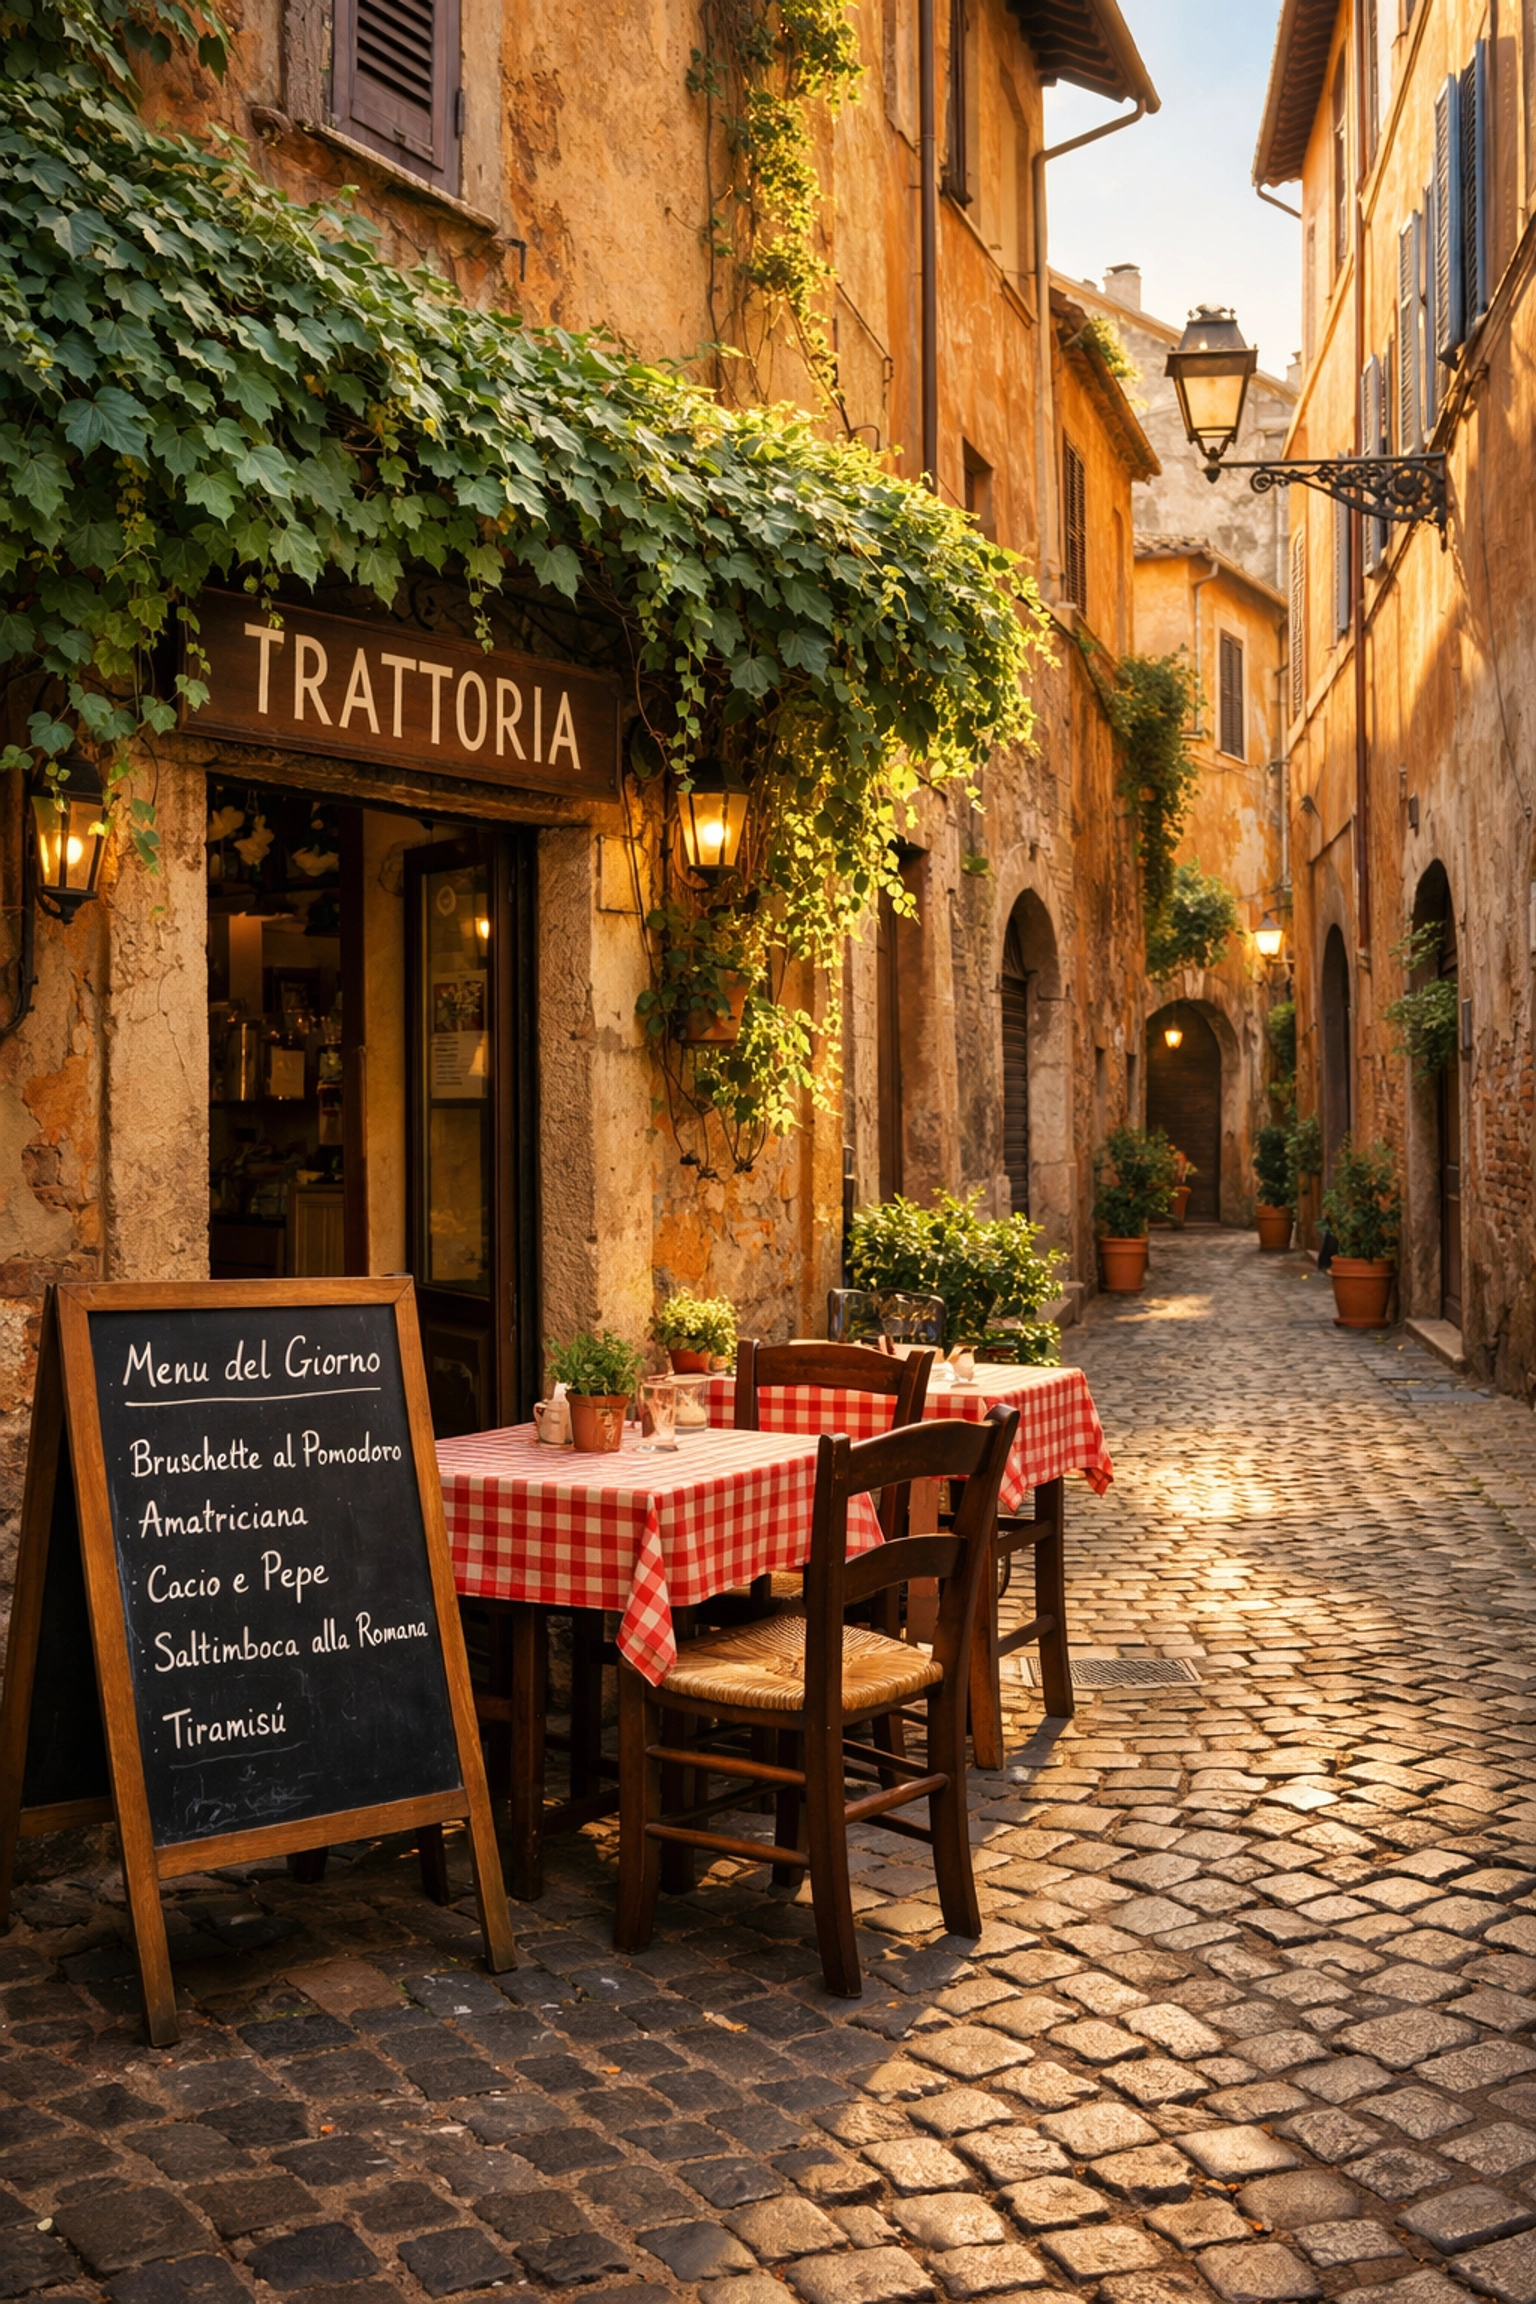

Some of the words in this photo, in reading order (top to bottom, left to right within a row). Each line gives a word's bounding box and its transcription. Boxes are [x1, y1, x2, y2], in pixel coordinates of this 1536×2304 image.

[244, 624, 581, 770] TRATTORIA
[122, 1341, 209, 1388] Menu
[225, 1339, 271, 1382] del
[285, 1334, 381, 1379] Giorno
[130, 1435, 262, 1478] Bruschette
[273, 1433, 296, 1468] al
[302, 1430, 402, 1466] Pomodoro
[139, 1499, 308, 1539] Amatriciana
[147, 1564, 220, 1604] Cacio
[232, 1573, 249, 1593] e
[261, 1550, 329, 1603] Pepe
[154, 1626, 299, 1672] Saltimboca
[312, 1618, 350, 1653] alla
[355, 1611, 428, 1648] Romana
[162, 1702, 287, 1749] Tiramisú
